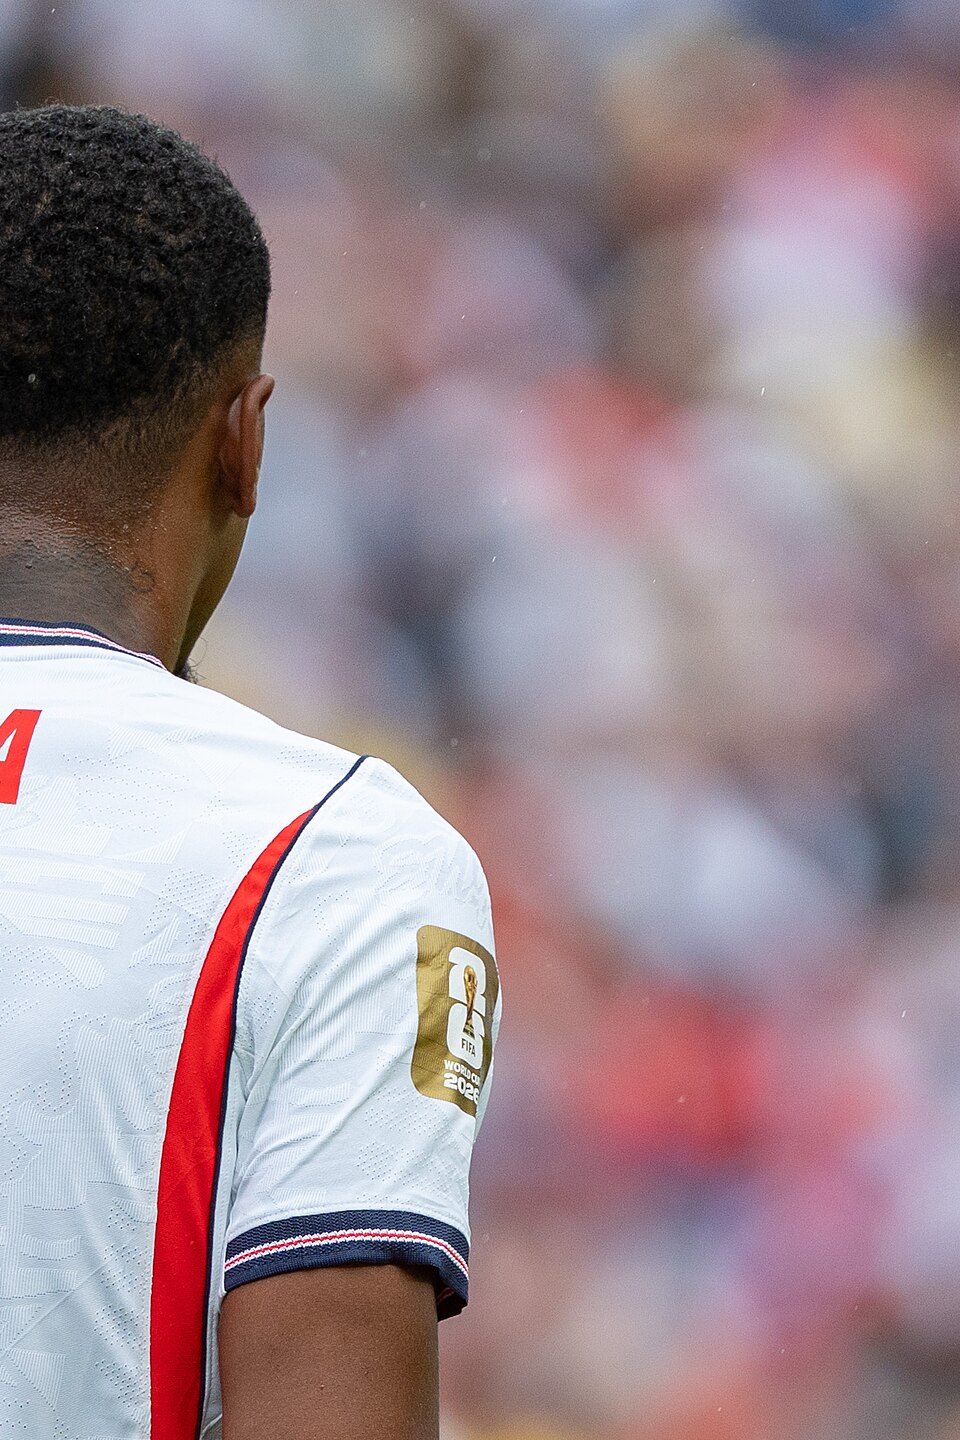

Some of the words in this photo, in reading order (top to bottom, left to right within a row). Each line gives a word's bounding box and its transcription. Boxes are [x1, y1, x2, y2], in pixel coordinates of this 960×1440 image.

[461, 1037, 476, 1057] FIFA
[443, 1059, 471, 1080] WORLD
[471, 1072, 481, 1087] CU
[443, 1072, 480, 1105] 2026
